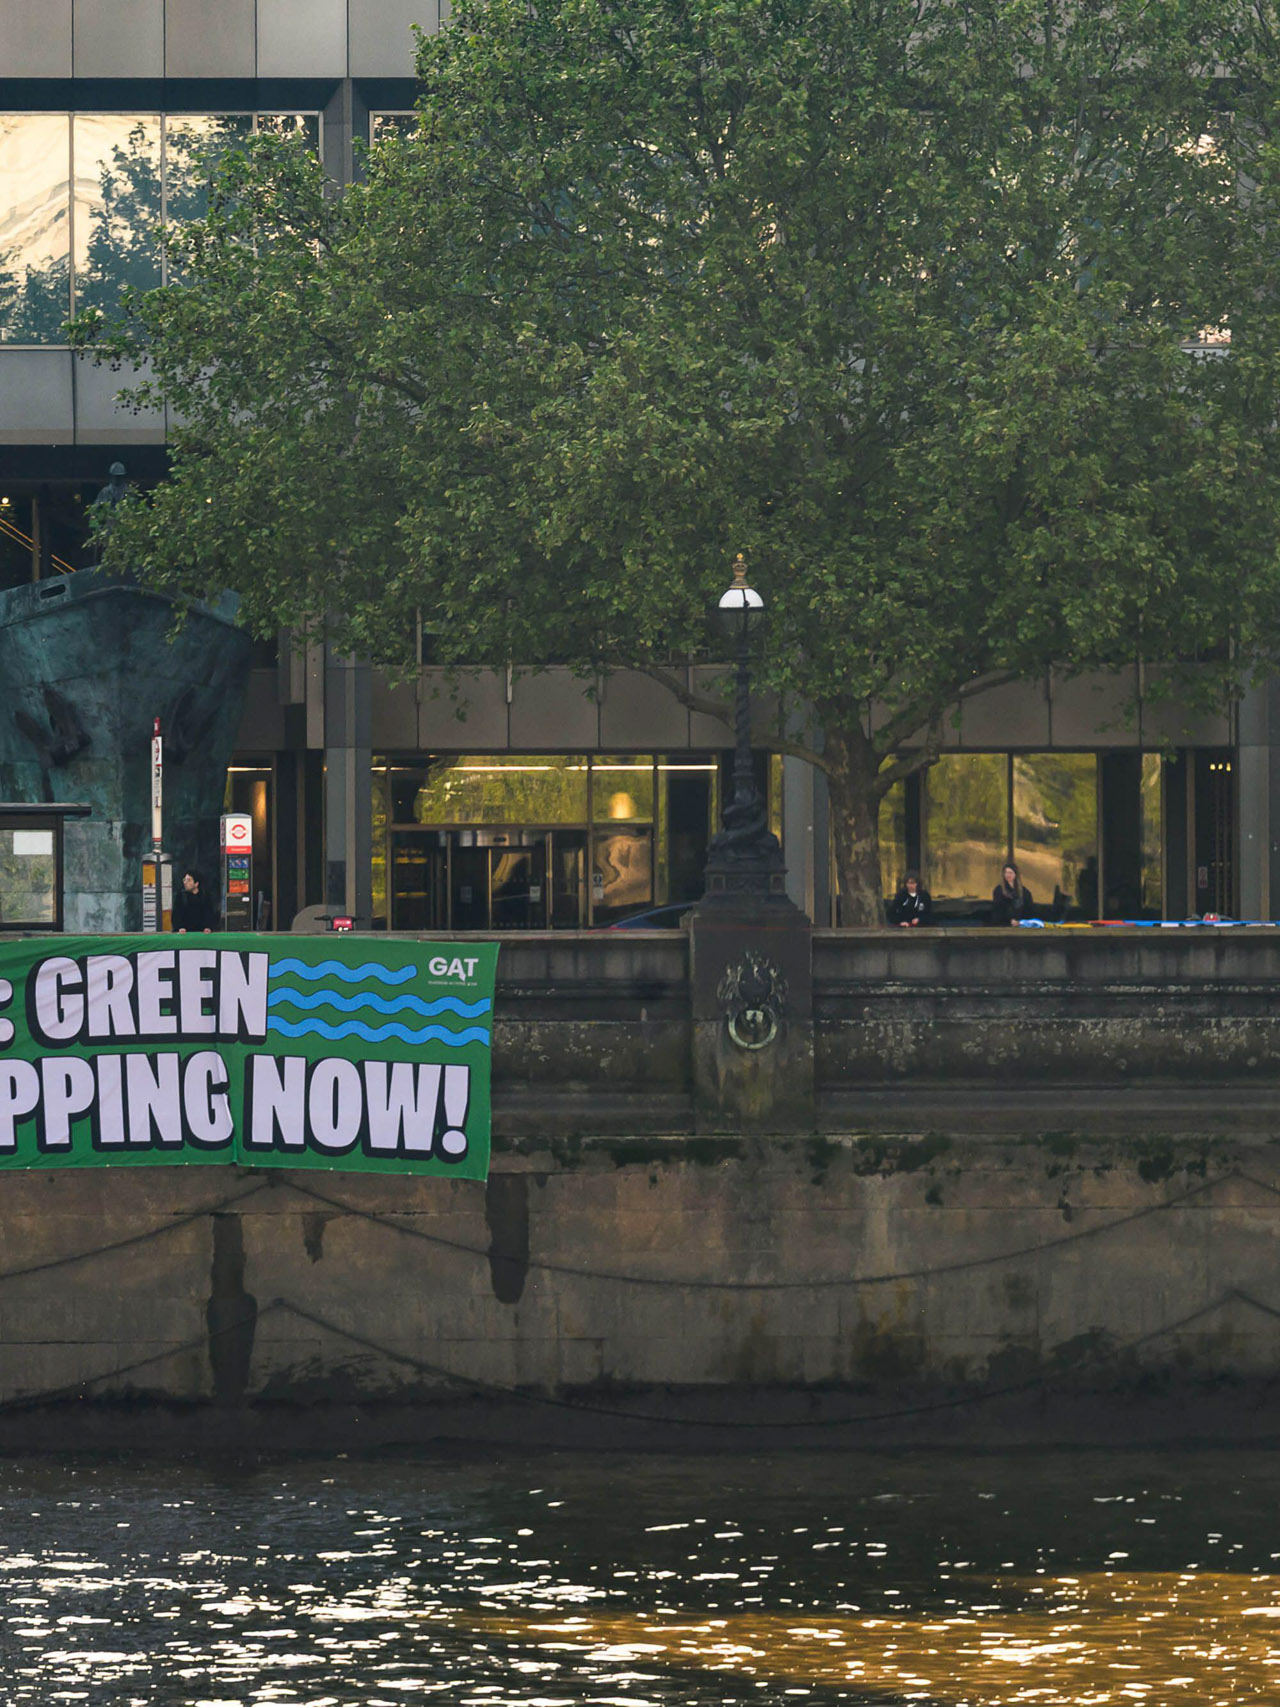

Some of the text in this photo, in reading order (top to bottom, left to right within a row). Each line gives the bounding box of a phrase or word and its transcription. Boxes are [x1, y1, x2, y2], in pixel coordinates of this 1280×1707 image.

[36, 949, 269, 1040] GREEN
[428, 957, 479, 982] GAT
[251, 1054, 469, 1154] NOW!
